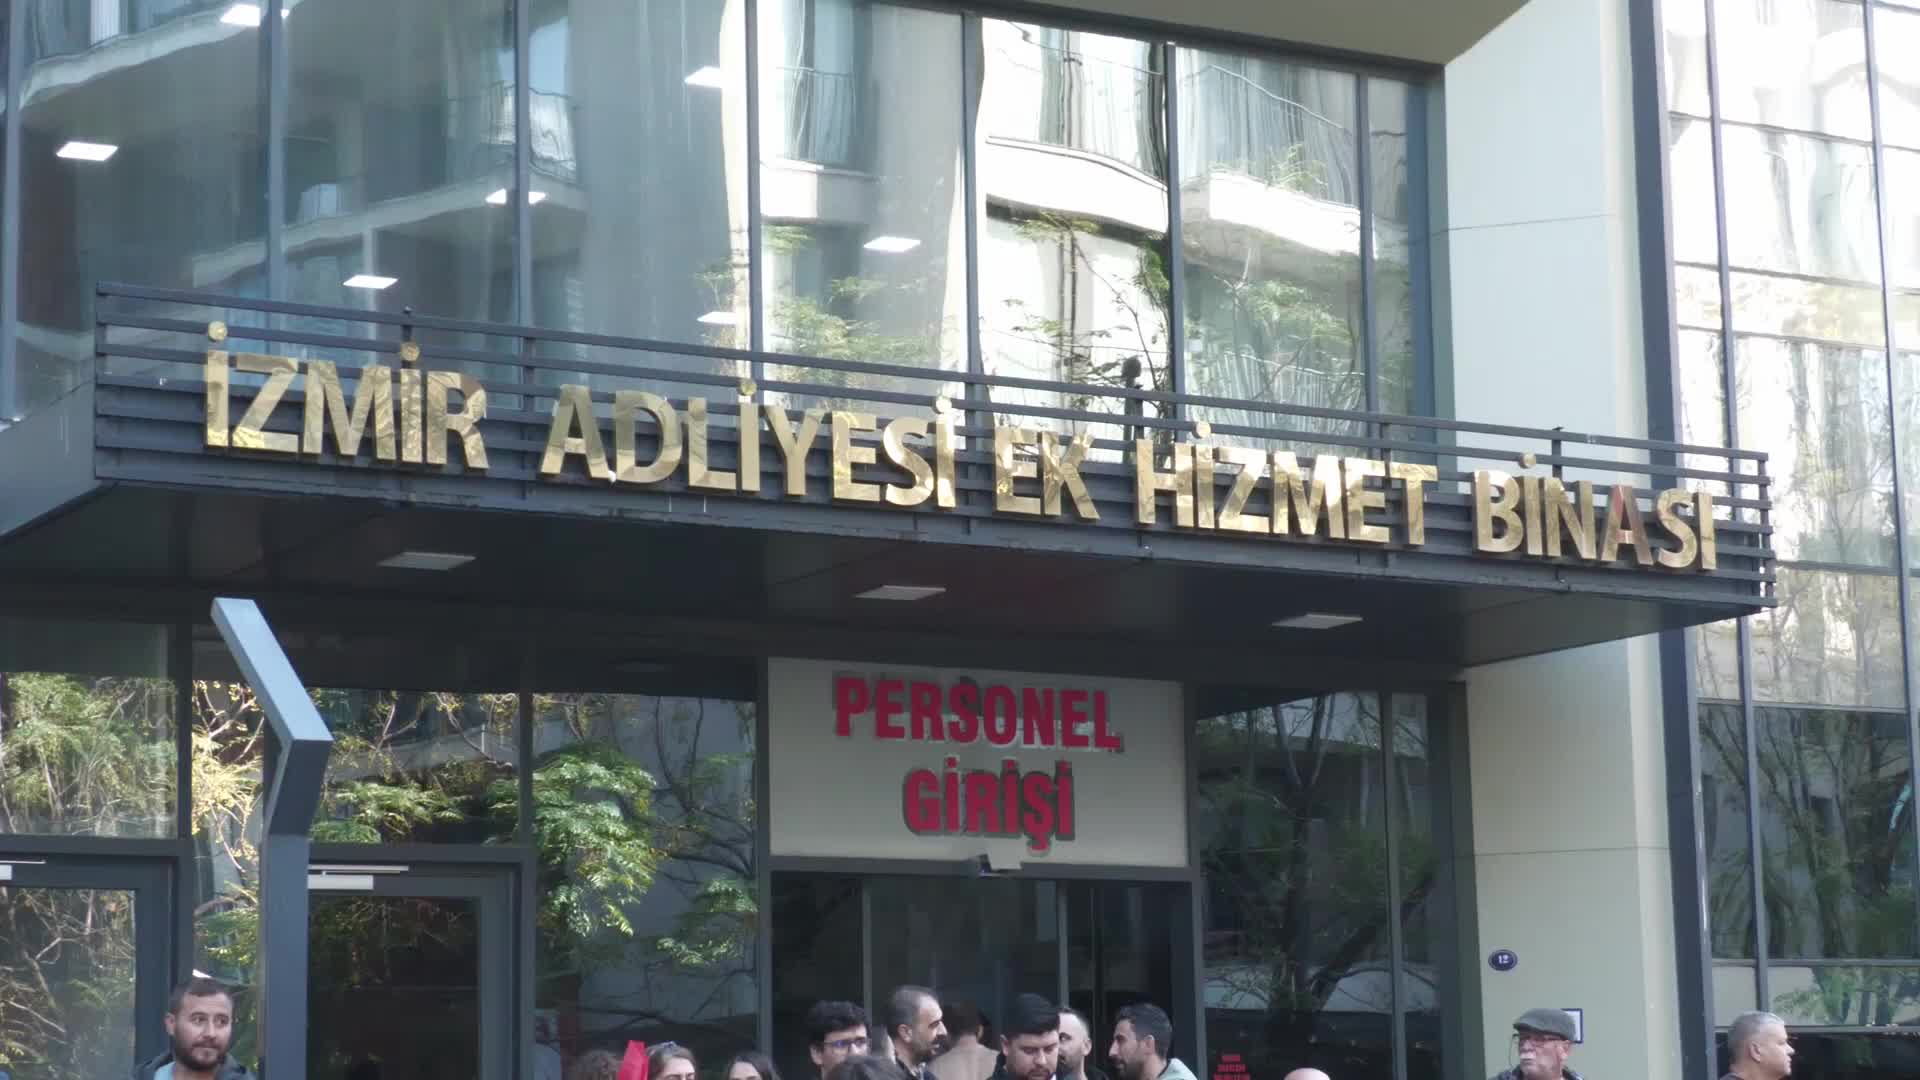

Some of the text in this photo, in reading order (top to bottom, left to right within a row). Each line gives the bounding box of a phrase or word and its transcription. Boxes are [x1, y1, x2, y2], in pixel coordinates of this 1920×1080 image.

[204, 321, 1717, 570] İZMİR ADLİYESİ EK HİZMET BİNASI
[833, 675, 1122, 752] PERSONEL
[904, 756, 1074, 851] GİRİŞİ
